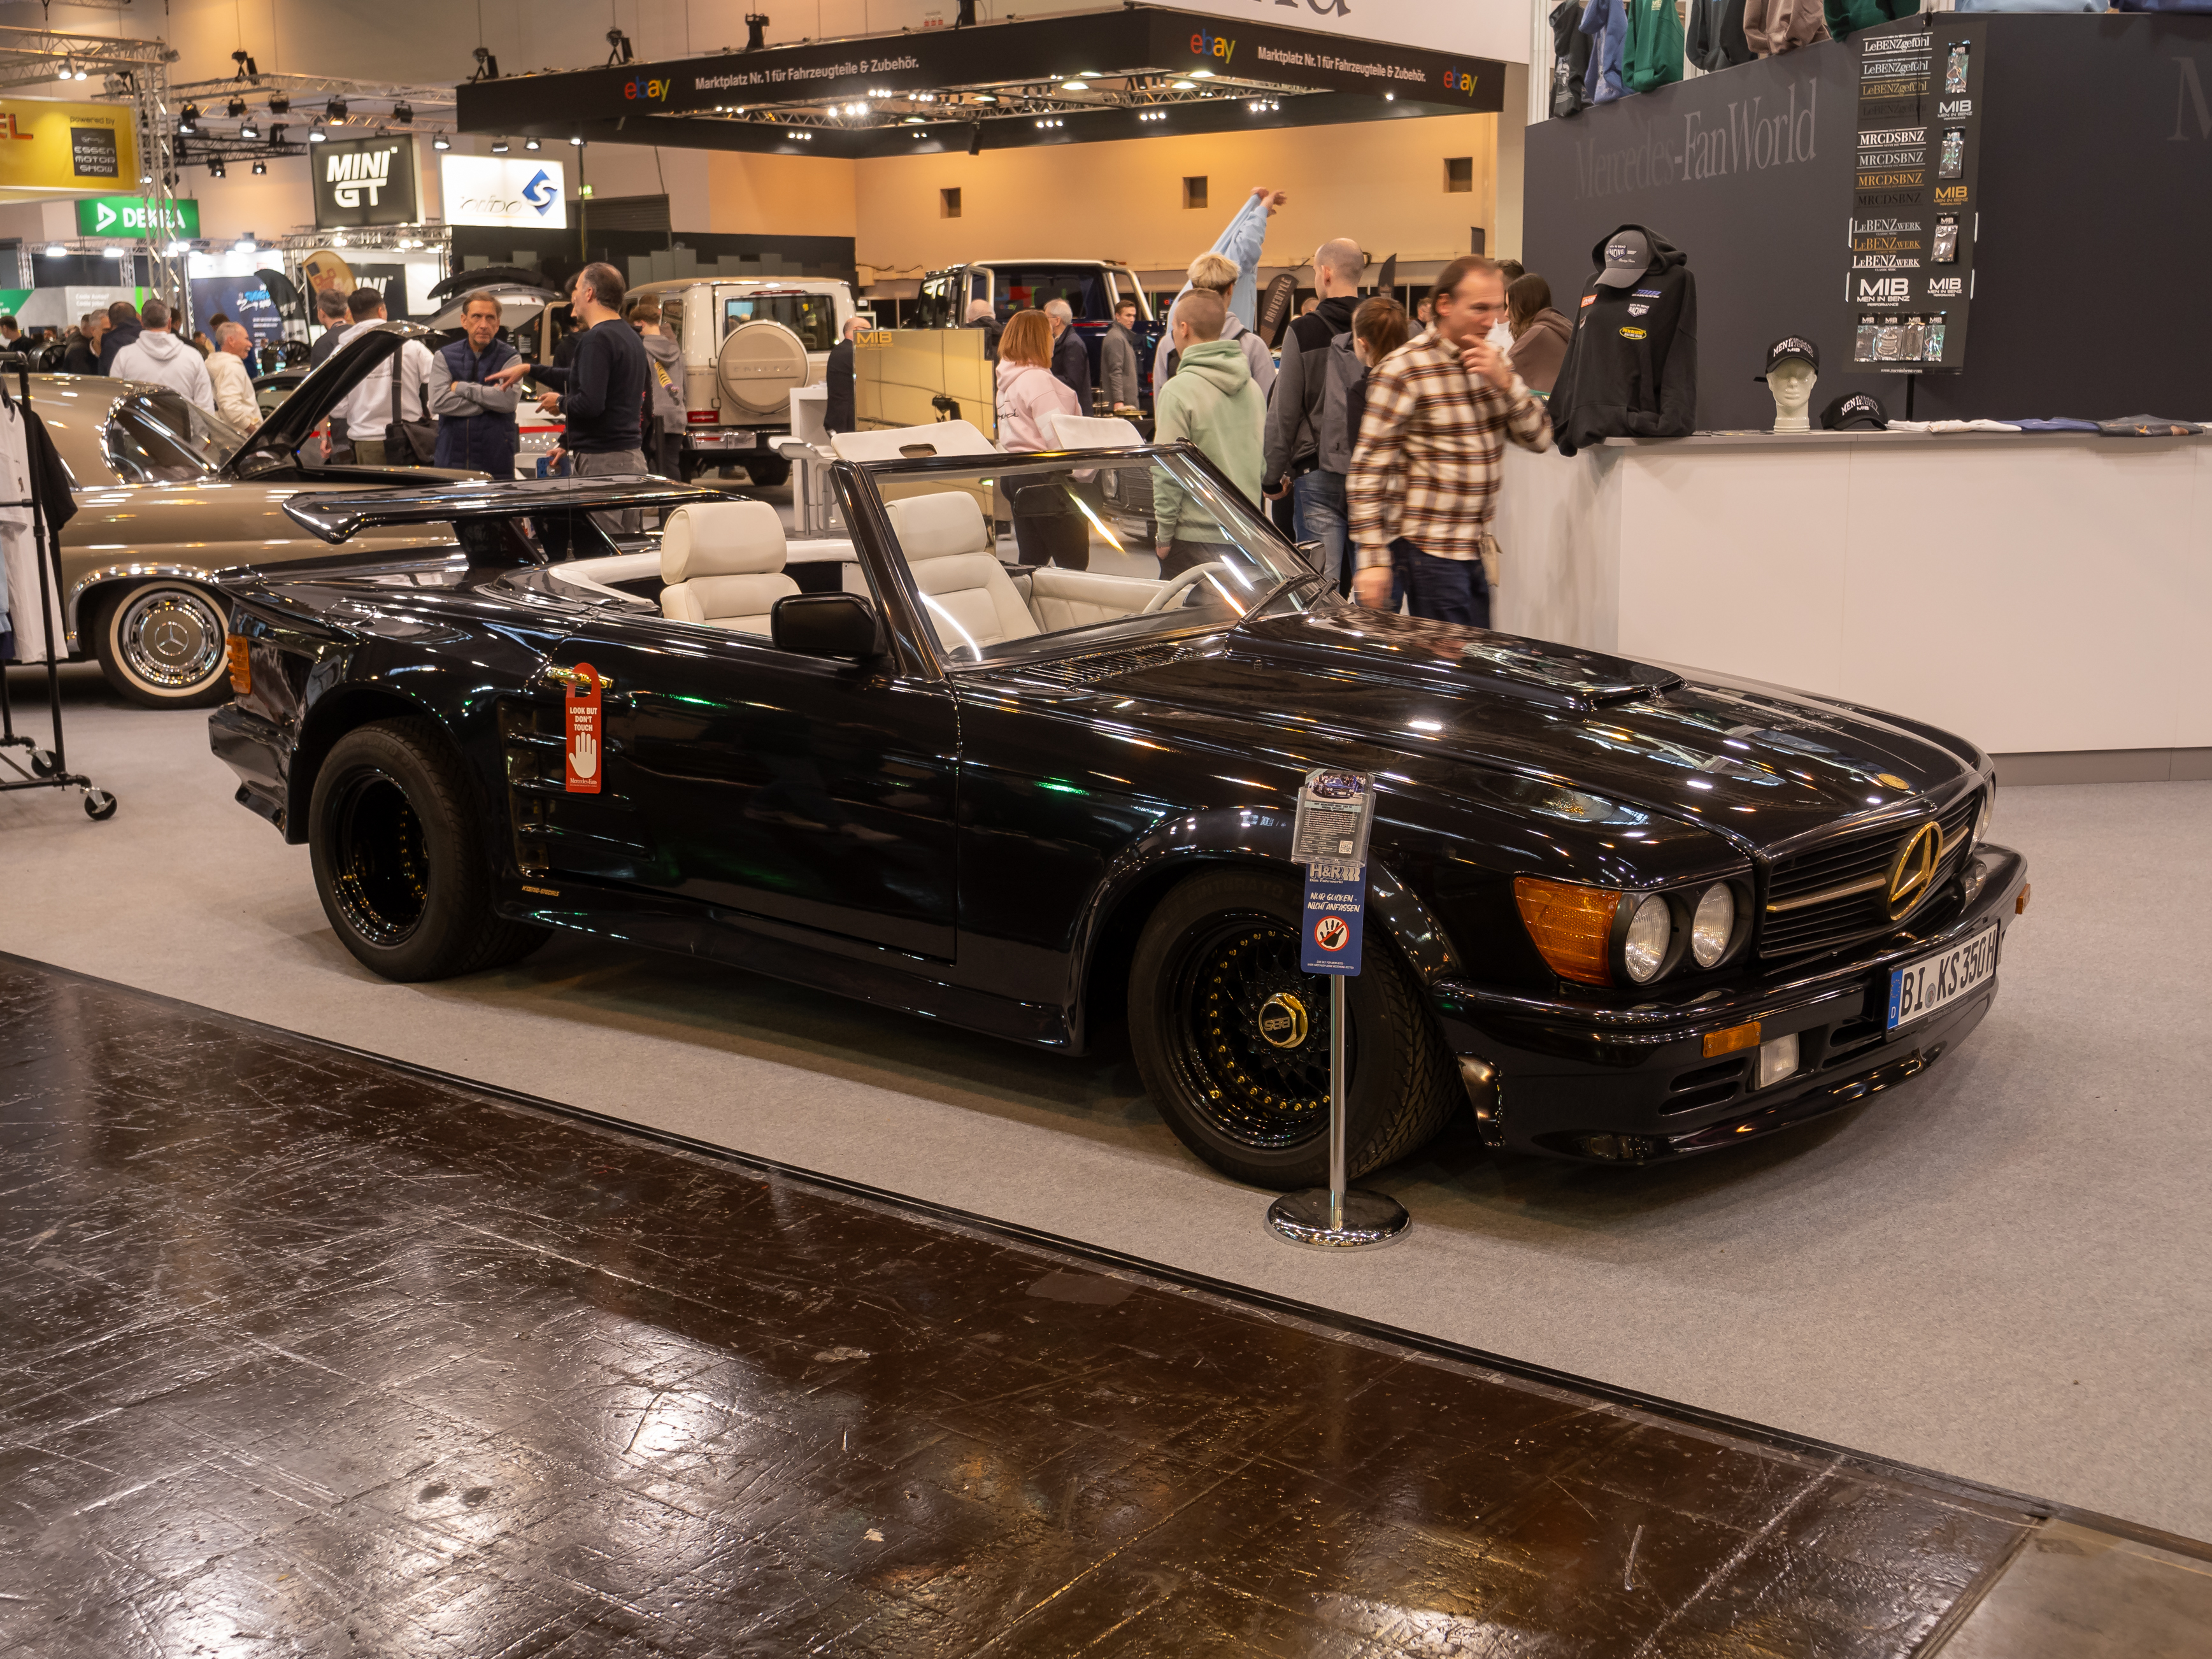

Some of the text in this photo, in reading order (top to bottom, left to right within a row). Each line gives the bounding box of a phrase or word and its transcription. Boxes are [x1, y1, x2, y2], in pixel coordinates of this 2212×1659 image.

[1190, 29, 1236, 64] ebay
[1865, 36, 1930, 52] LeBENZgefühl
[1257, 46, 1427, 82] Marktplatz Nr. 1 für Fahrzeugteile & Zubehör.
[1864, 61, 1929, 75] LeBENZgefühl
[695, 57, 920, 90] Marktplatz Nr. 1 für Fahrzeugteile & Zubehör.
[1443, 66, 1478, 97] ebay
[624, 76, 671, 102] ebay
[1939, 99, 1972, 113] MIB
[0, 113, 34, 140] L
[70, 116, 115, 126] powered by
[1860, 131, 1925, 145] MRCDSBNZ
[74, 146, 115, 155] ESSEN
[75, 155, 115, 164] MOTOR
[327, 150, 390, 182] MINI
[1859, 152, 1923, 166] MRCDSBNZ
[80, 164, 113, 173] SHOW
[1859, 173, 1922, 187] MRCDSBNZ
[334, 178, 387, 208] GT
[1935, 186, 1967, 199] MIB
[122, 208, 186, 229] DEKRA
[1609, 248, 1624, 257] RACING
[1860, 278, 1909, 296] MIB
[1929, 278, 1962, 290] MIB
[1264, 277, 1292, 323] DRIVESTYLE
[1629, 306, 1647, 315] RACING
[857, 332, 892, 343] MIB
[1310, 864, 1343, 879] H&R
[1310, 892, 1325, 901] NUR
[1327, 894, 1353, 902] GUCKEN
[1308, 902, 1360, 913] NICHT ANFASSEN
[1901, 929, 1997, 1017] BI KS 350H
[1891, 1006, 1896, 1019] D
